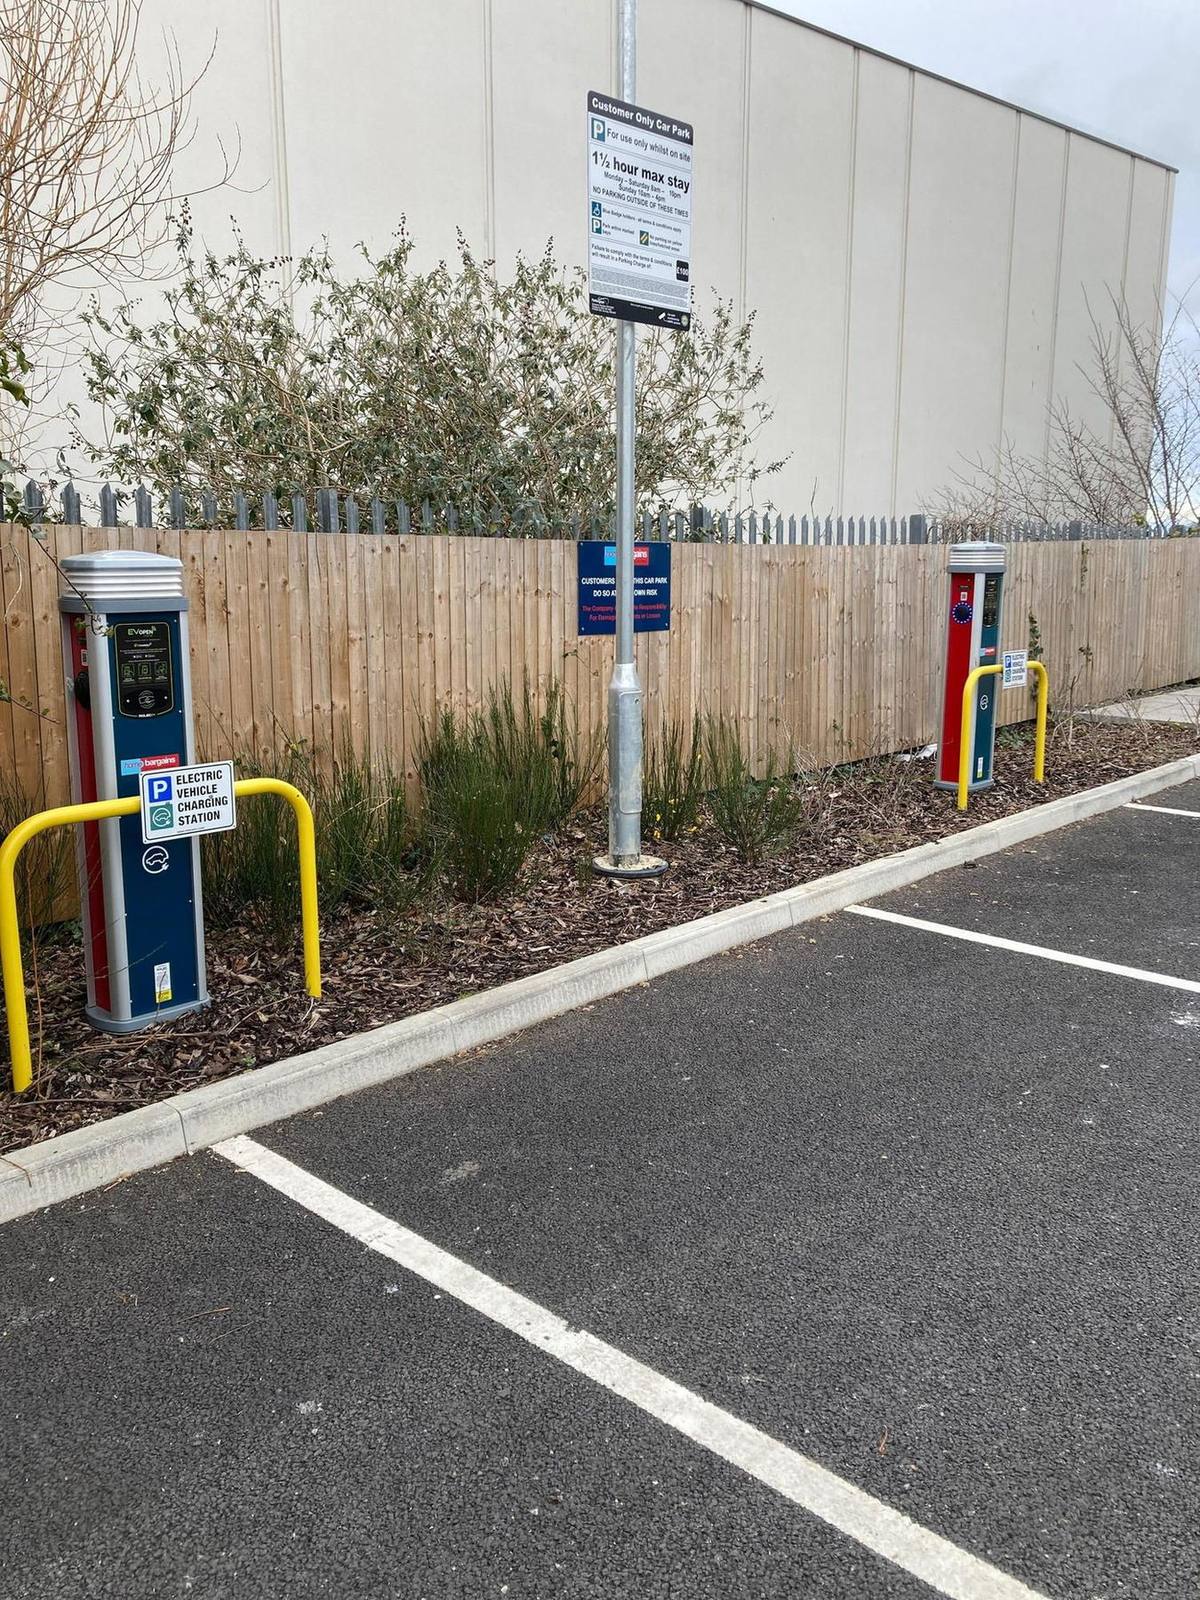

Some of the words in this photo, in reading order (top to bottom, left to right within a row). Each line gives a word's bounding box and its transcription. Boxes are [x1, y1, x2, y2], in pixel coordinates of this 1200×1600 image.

[592, 97, 634, 120] Customer
[636, 112, 654, 128] Only
[656, 119, 670, 132] Car
[672, 124, 690, 139] Park
[593, 120, 604, 139] P
[607, 128, 618, 139] For
[620, 134, 632, 144] use
[634, 138, 648, 151] only
[650, 142, 668, 156] whilst
[670, 150, 678, 158] on
[679, 152, 690, 162] site
[604, 171, 624, 184] Monday
[628, 178, 650, 192] Saturday
[613, 156, 639, 176] hour
[642, 168, 664, 184] max
[668, 176, 690, 194] stay
[592, 186, 601, 194] NO
[602, 188, 625, 200] PARKING
[626, 195, 649, 207] OUTSIDE
[658, 203, 673, 214] THESE
[674, 208, 688, 218] TIMES
[618, 183, 636, 196] Sunday
[638, 189, 651, 198] 10am
[655, 194, 666, 202] 4pm
[593, 220, 599, 232] P
[618, 256, 632, 266] Parking
[632, 259, 646, 268] Charge
[144, 757, 176, 767] bargains
[176, 769, 223, 785] ELECTRIC
[153, 780, 168, 800] P
[177, 784, 217, 798] VEHICLE
[178, 796, 228, 812] CHARGING
[178, 811, 220, 826] STATION
